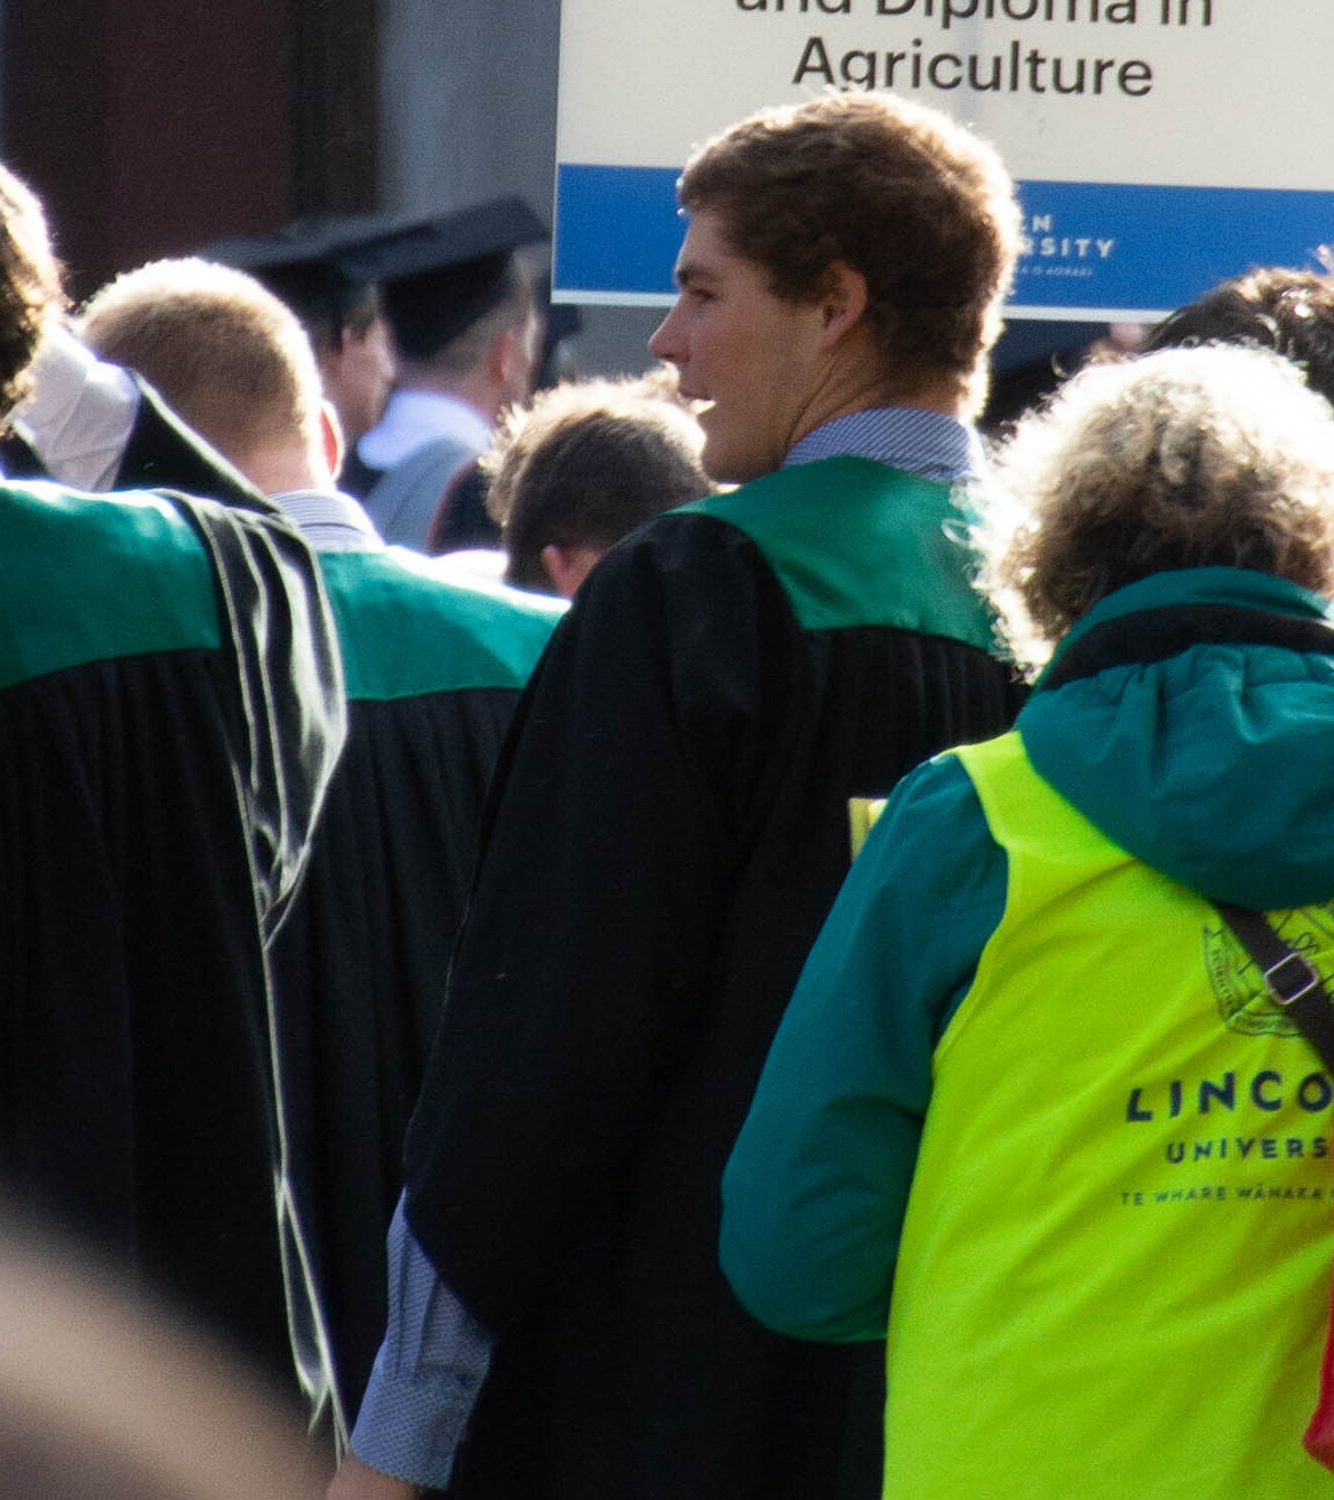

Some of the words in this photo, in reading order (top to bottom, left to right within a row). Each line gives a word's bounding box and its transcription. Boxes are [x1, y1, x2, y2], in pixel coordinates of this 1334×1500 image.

[791, 35, 1154, 97] Agriculture
[1125, 1070, 1334, 1123] LINCO
[1166, 1136, 1328, 1164] UNIVERS
